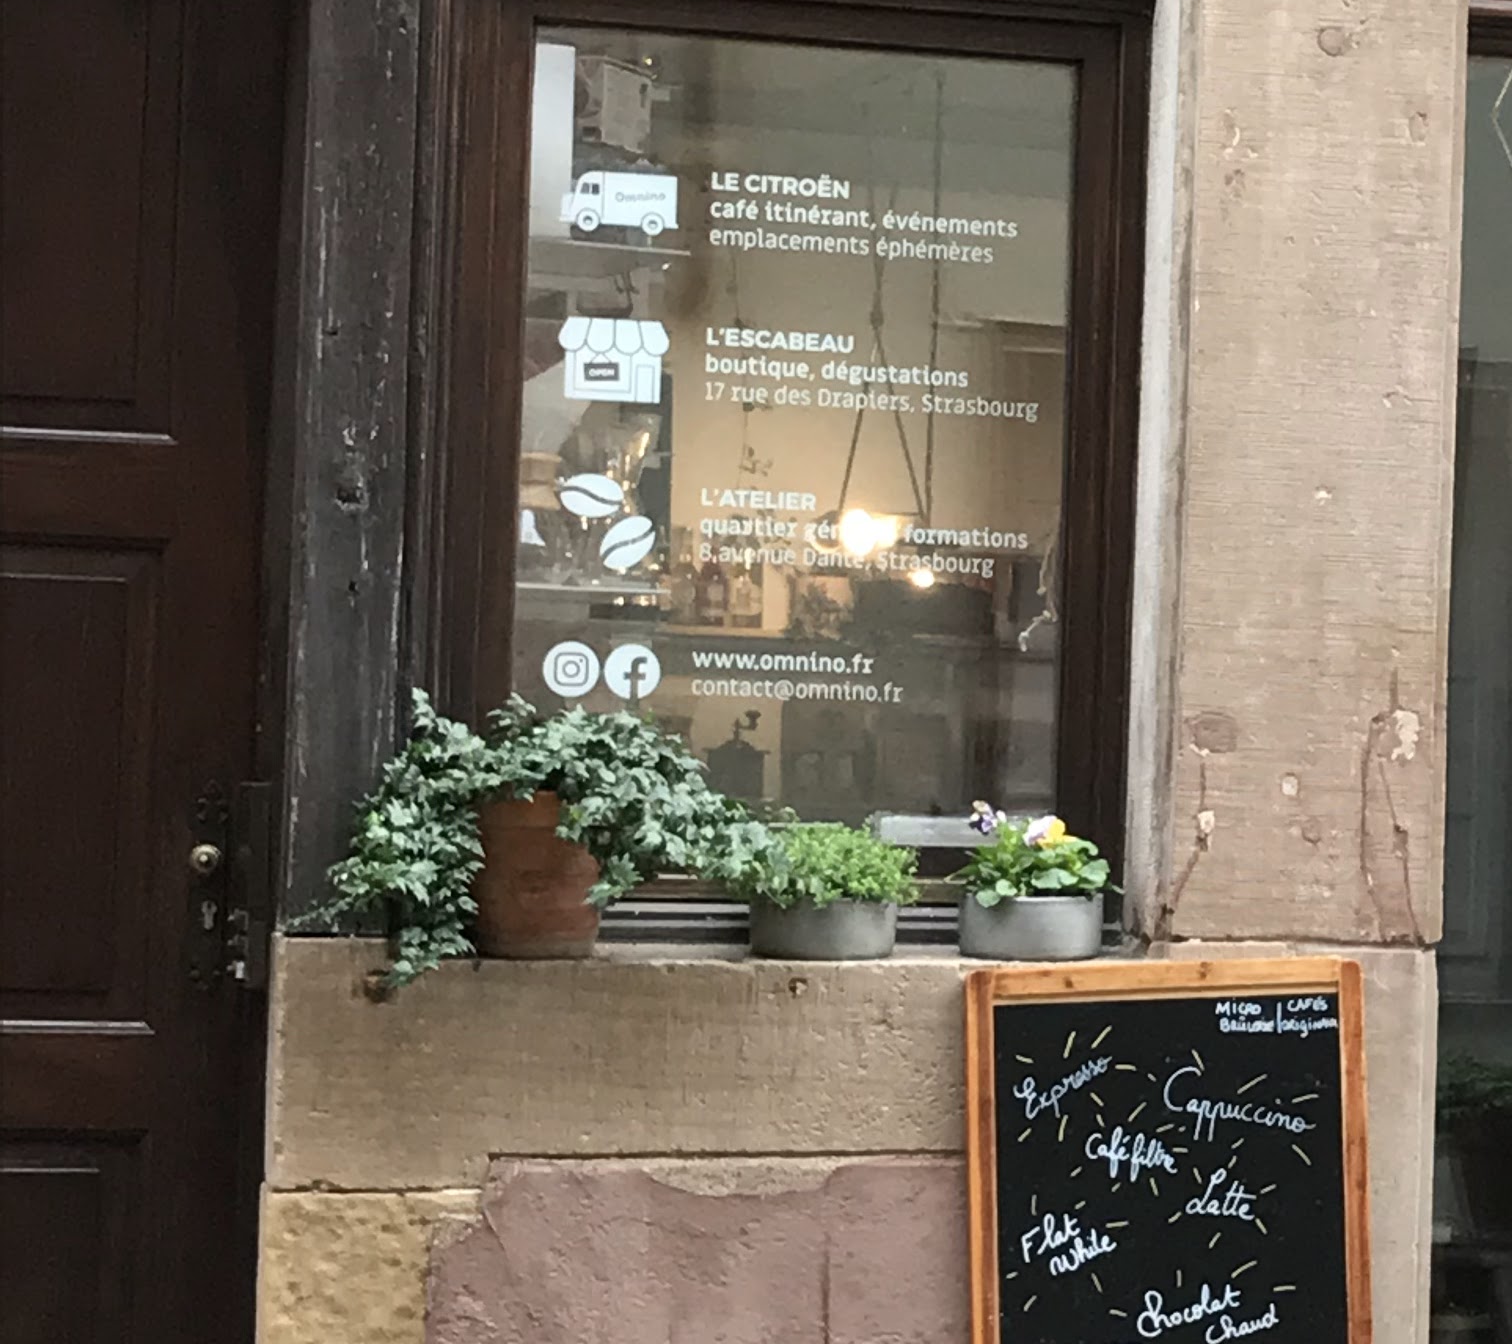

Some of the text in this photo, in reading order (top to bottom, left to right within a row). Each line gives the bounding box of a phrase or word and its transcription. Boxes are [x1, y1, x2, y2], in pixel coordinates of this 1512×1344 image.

[711, 172, 850, 199] LE CITROËN
[710, 200, 1018, 238] café itinérant, événements
[709, 227, 993, 263] emplacements éphémères
[706, 327, 854, 354] L'ESCABEAU
[705, 353, 968, 388] boutique, dégustations
[704, 382, 1039, 422] 17 rue des Drapiers, Strasbourg
[701, 488, 816, 511] L'ATELIER
[700, 516, 797, 542] quartier
[904, 523, 1028, 549] formations
[878, 552, 995, 578] Strasbourg
[692, 651, 874, 674] www.omnino.fr
[691, 676, 903, 702] contact@omnino.fr
[1013, 1056, 1112, 1120] Expresso
[1163, 1066, 1316, 1142] Cappuccino
[1085, 1126, 1178, 1183] Café filtre
[1185, 1168, 1257, 1220] Latte
[1021, 1213, 1081, 1263] Flat
[1136, 1283, 1242, 1337] Chocolat
